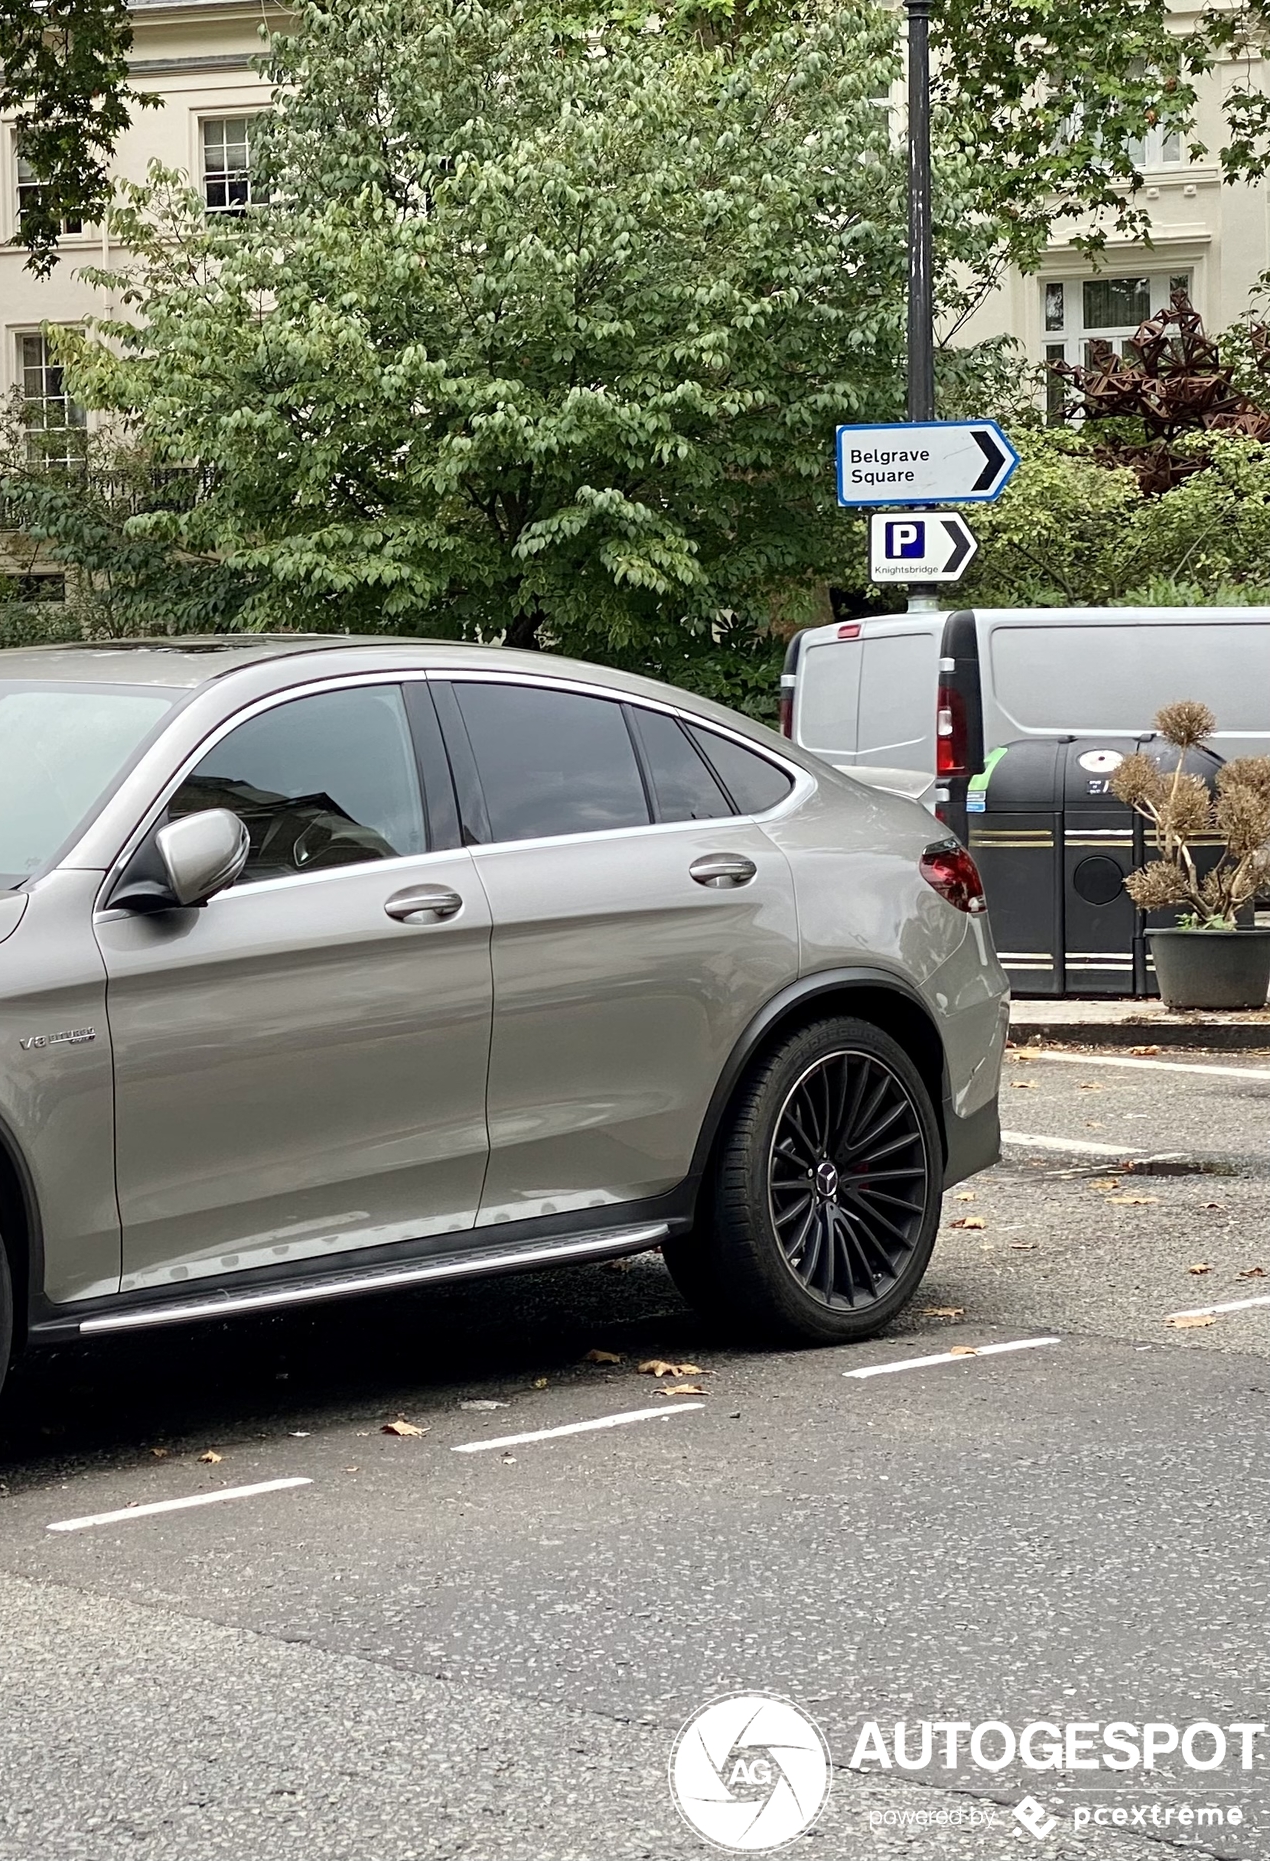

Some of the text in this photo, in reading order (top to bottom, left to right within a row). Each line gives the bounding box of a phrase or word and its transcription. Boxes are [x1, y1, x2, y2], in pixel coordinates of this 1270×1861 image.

[851, 449, 930, 465] Belgrave
[851, 469, 915, 485] Square
[892, 524, 917, 556] P
[875, 565, 939, 575] Knightsbridge
[19, 1036, 47, 1050] V8
